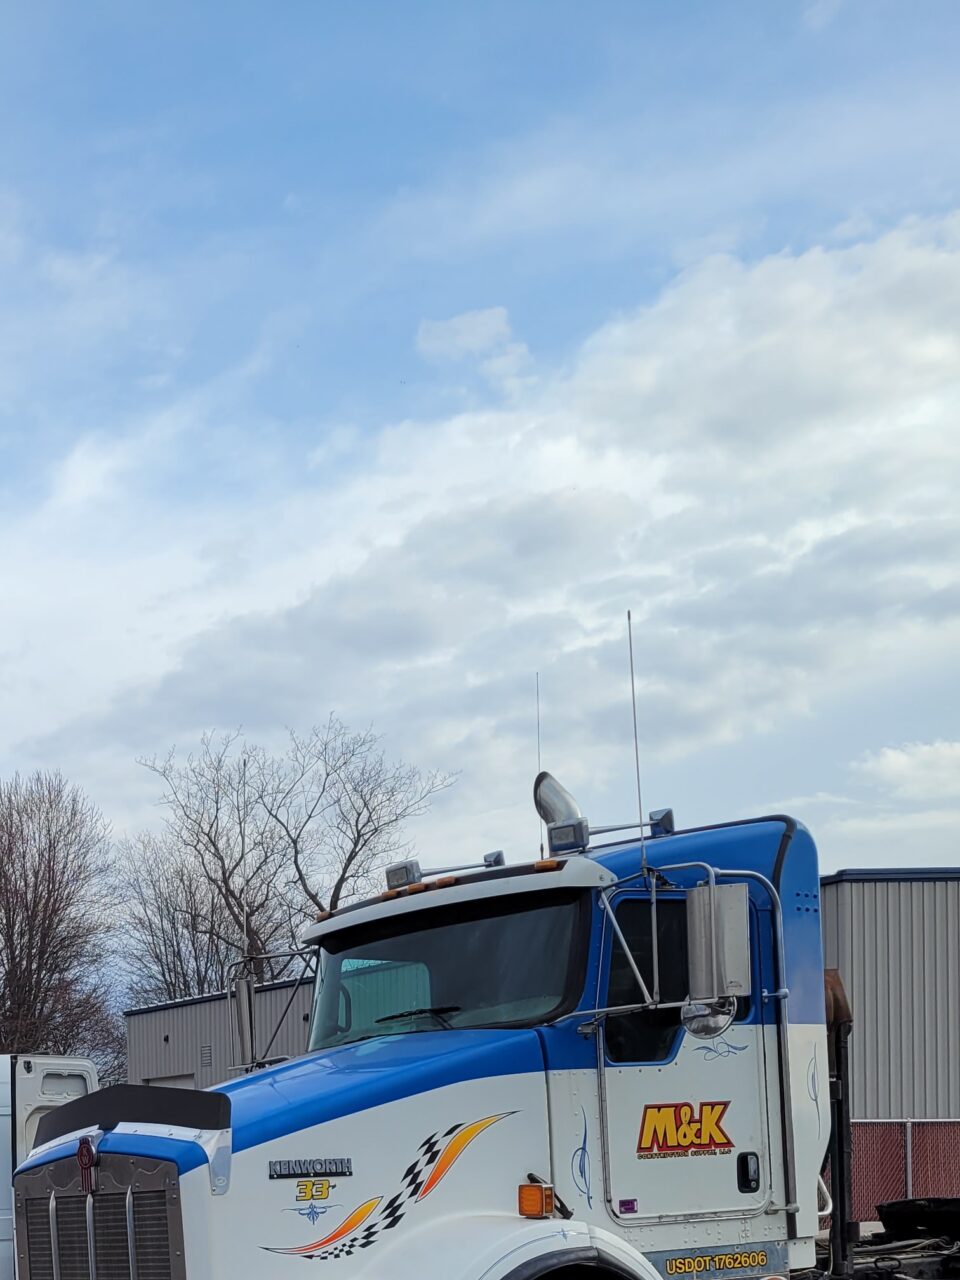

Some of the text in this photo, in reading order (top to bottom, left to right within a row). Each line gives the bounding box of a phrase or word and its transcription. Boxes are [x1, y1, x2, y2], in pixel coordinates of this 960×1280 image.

[638, 1102, 732, 1150] M&K
[268, 1158, 352, 1175] KENWORTH
[296, 1179, 331, 1202] 33
[666, 1251, 767, 1275] USDOT 1762606
